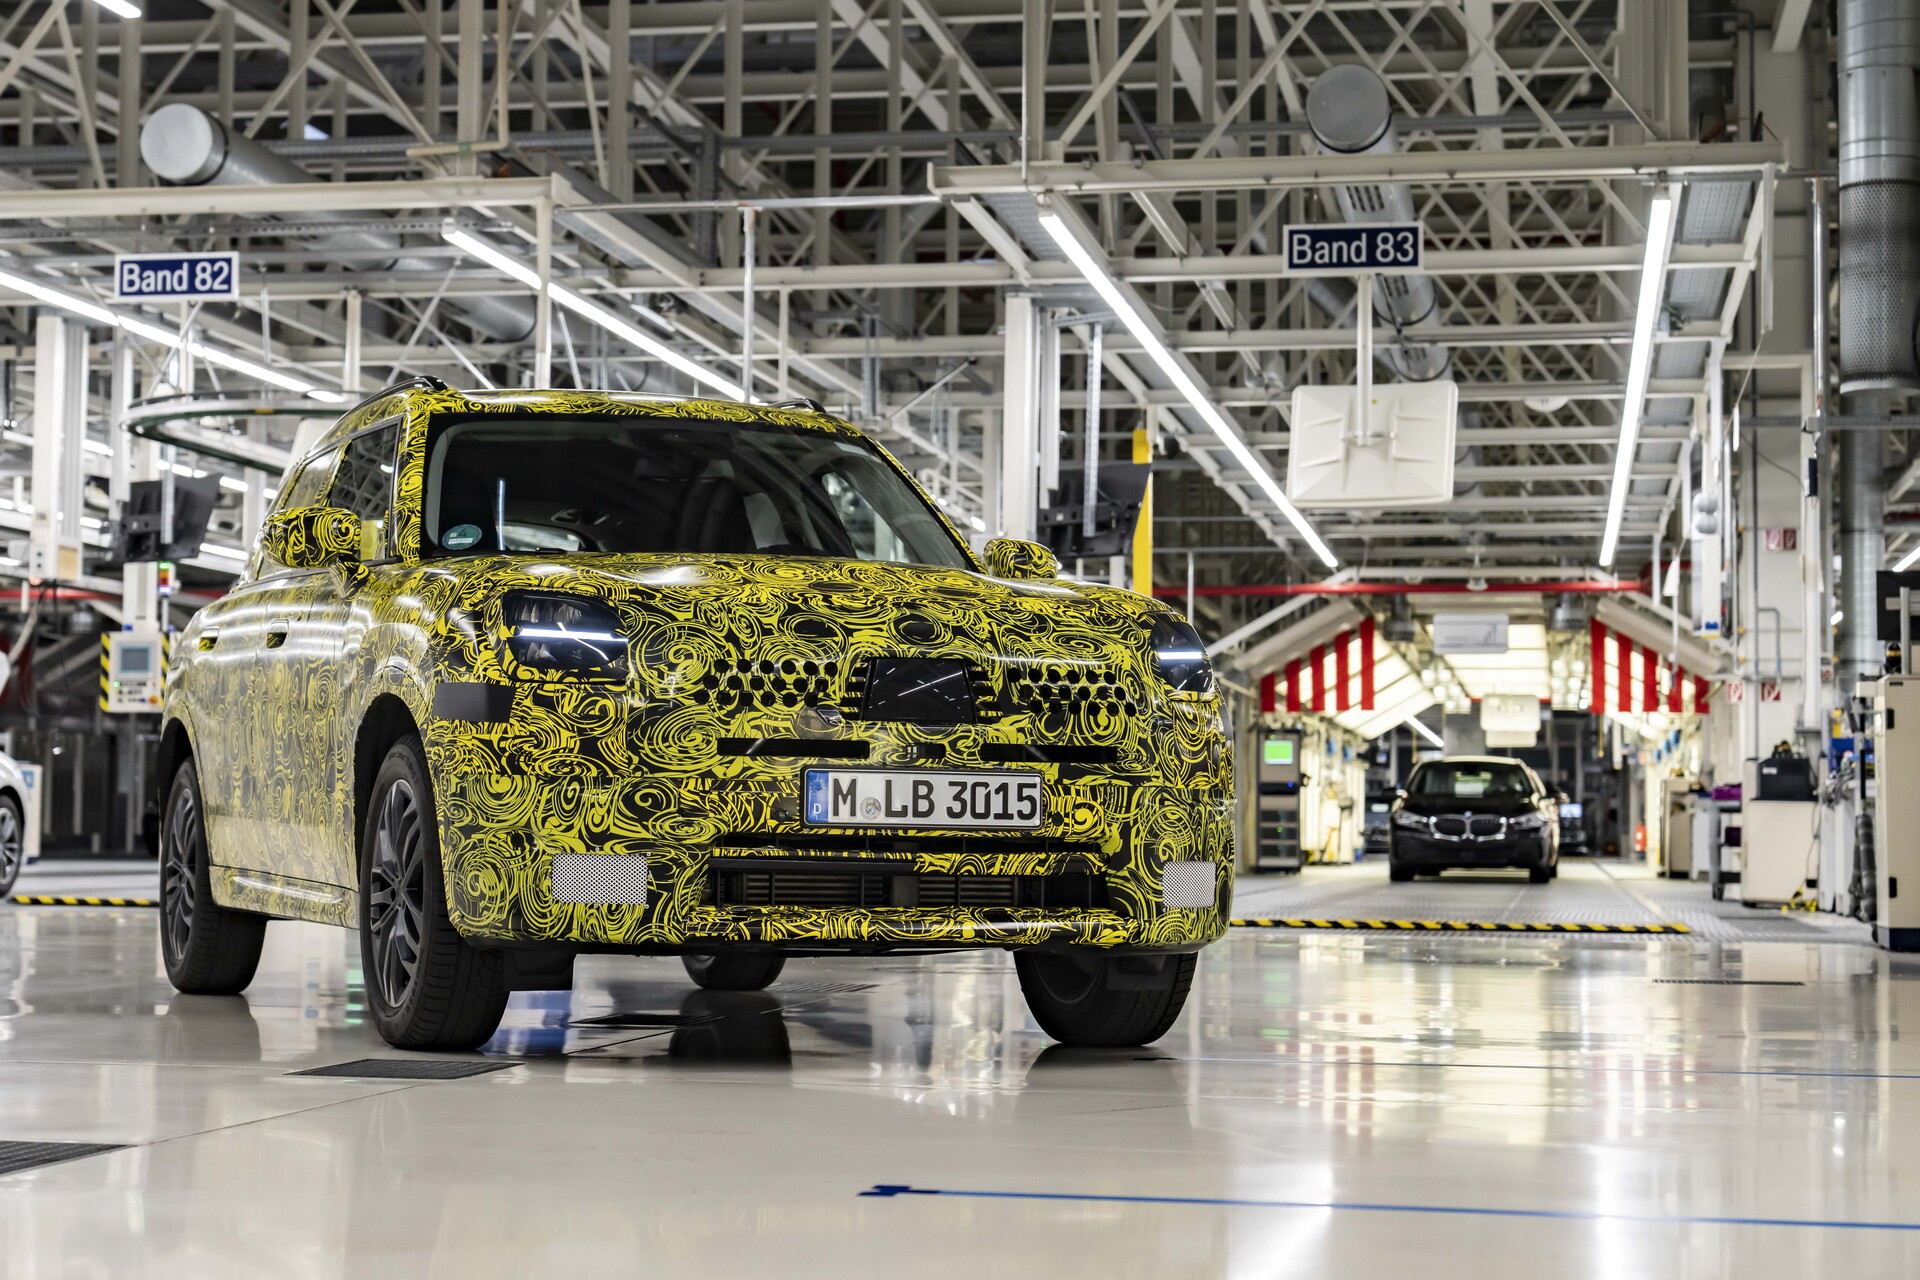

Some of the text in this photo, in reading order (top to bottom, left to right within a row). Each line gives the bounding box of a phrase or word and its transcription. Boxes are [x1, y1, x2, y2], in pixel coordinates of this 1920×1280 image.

[1292, 231, 1414, 264] Band 83
[122, 260, 229, 293] Band 82
[813, 803, 822, 815] D
[833, 777, 1038, 821] M LB 3015
